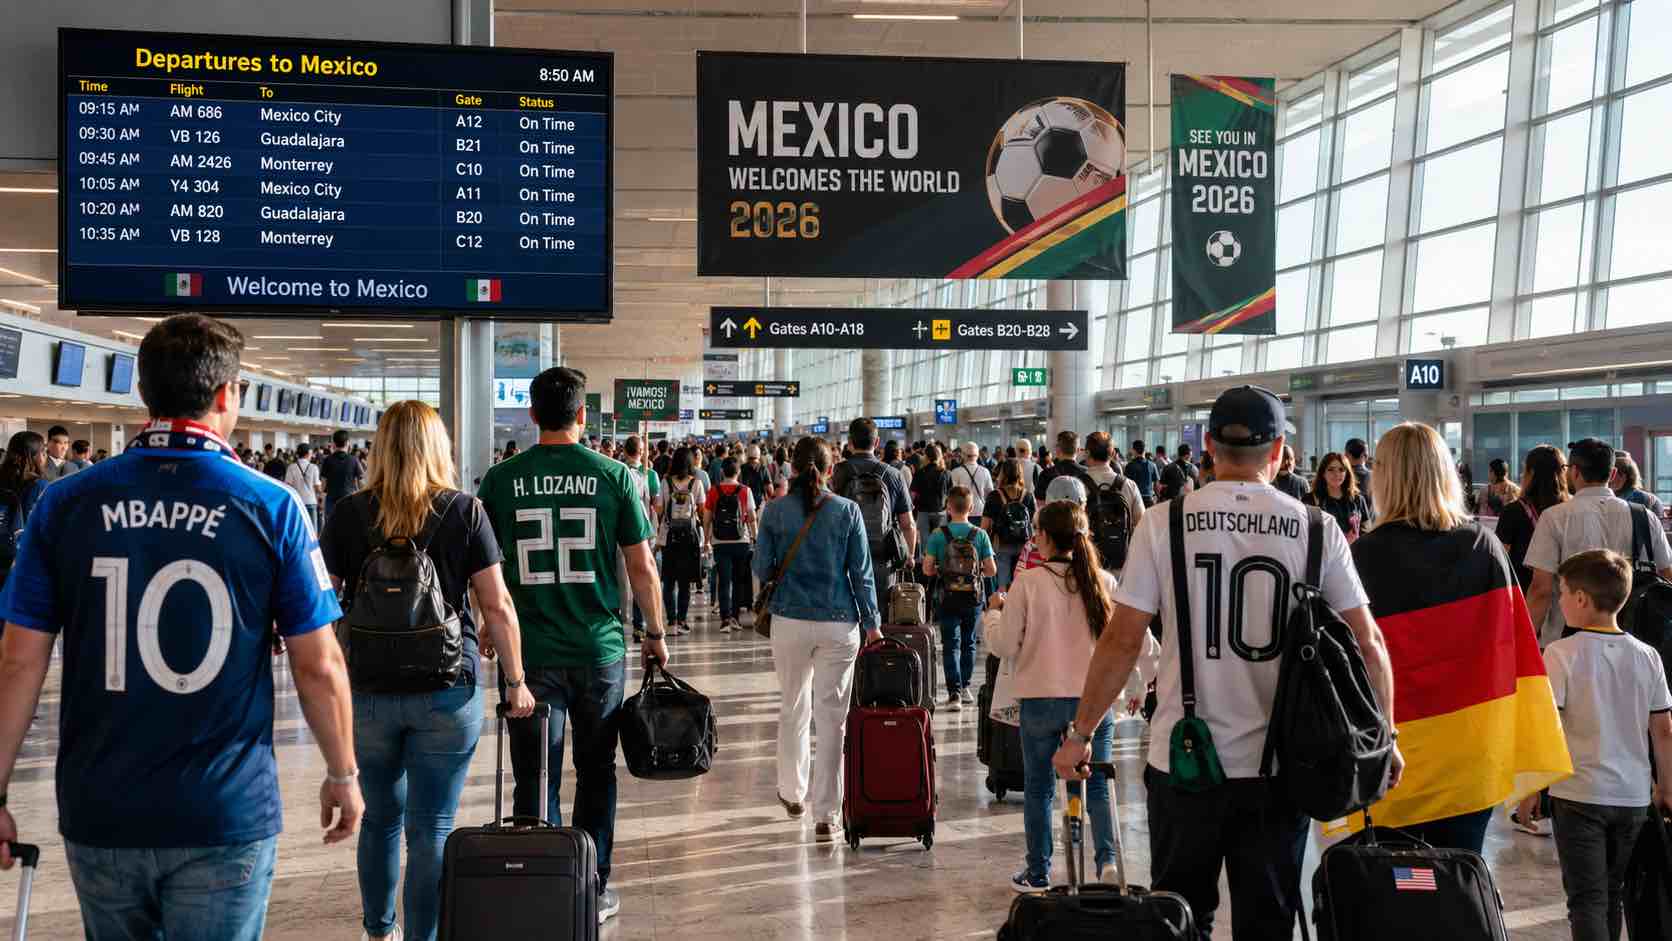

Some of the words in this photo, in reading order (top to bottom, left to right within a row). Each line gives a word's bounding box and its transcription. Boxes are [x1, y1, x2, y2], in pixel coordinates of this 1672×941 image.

[137, 48, 261, 72] Departures
[270, 56, 292, 72] to
[302, 55, 377, 76] Mexico
[540, 68, 568, 81] 8:50
[573, 70, 593, 82] AM
[80, 80, 108, 91] Time
[171, 84, 203, 97] Flight
[260, 87, 273, 97] To
[456, 95, 482, 105] Gate
[520, 97, 553, 107] Status
[80, 102, 115, 115] 09:15
[120, 104, 139, 115] AM
[171, 105, 192, 117] AM
[198, 106, 222, 118] 686
[261, 108, 309, 122] Mexico
[314, 110, 341, 126] City
[456, 115, 482, 128] A12
[520, 117, 538, 129] On
[543, 118, 574, 130] Time
[729, 100, 918, 159] MEXICO
[80, 127, 115, 140] 09:30
[120, 128, 139, 140] AM
[171, 130, 190, 142] VB
[196, 131, 220, 143] 126
[261, 132, 344, 149] Guadalajara
[457, 139, 480, 151] B21
[520, 141, 538, 153] On
[543, 141, 574, 154] Time
[1190, 130, 1212, 143] SEE
[1216, 130, 1239, 144] YOU
[1244, 132, 1255, 145] IN
[80, 152, 115, 165] 09:45
[120, 153, 139, 165] AM
[171, 155, 192, 167] AM
[198, 156, 231, 168] 2426
[261, 157, 333, 174] Monterrey
[456, 163, 482, 175] C10
[520, 165, 538, 177] On
[542, 165, 574, 178] Time
[1179, 149, 1267, 178] MEXICO
[80, 177, 115, 190] 10:05
[120, 178, 139, 190] AM
[171, 179, 188, 192] Y4
[194, 180, 219, 192] 304
[261, 182, 310, 195] Mexico
[315, 183, 341, 199] City
[456, 187, 480, 200] A11
[520, 189, 538, 200] On
[542, 189, 574, 202] Time
[729, 168, 841, 191] WELCOMES
[848, 170, 884, 192] THE
[891, 170, 959, 192] WORLD
[1193, 185, 1254, 213] 2026
[80, 202, 115, 215] 10:20
[120, 203, 139, 215] AM
[171, 204, 192, 216] AM
[198, 205, 223, 217] 820
[261, 206, 344, 223] Guadalajara
[457, 211, 482, 223] B20
[520, 213, 538, 224] On
[542, 213, 575, 226] Time
[731, 201, 819, 238] 2026
[80, 228, 115, 240] 10:35
[120, 228, 139, 240] AM
[171, 229, 190, 241] VB
[196, 230, 220, 242] 128
[261, 231, 333, 248] Monterrey
[457, 235, 482, 248] C12
[520, 236, 538, 248] On
[543, 237, 575, 249] Time
[227, 277, 322, 296] Welcome
[329, 280, 349, 296] to
[358, 280, 427, 298] Mexico
[770, 322, 807, 335] Gates
[810, 323, 864, 335] A10-A18
[958, 324, 993, 336] Gates
[998, 325, 1050, 336] B20-B28
[1411, 365, 1439, 384] A10
[514, 478, 528, 497] H.
[534, 476, 597, 495] LOZANO
[102, 500, 226, 538] MBAPPÉ
[1186, 511, 1300, 539] DEUTSCHLAND
[516, 508, 598, 586] 22
[1194, 553, 1291, 662] 10
[92, 556, 233, 694] 10
